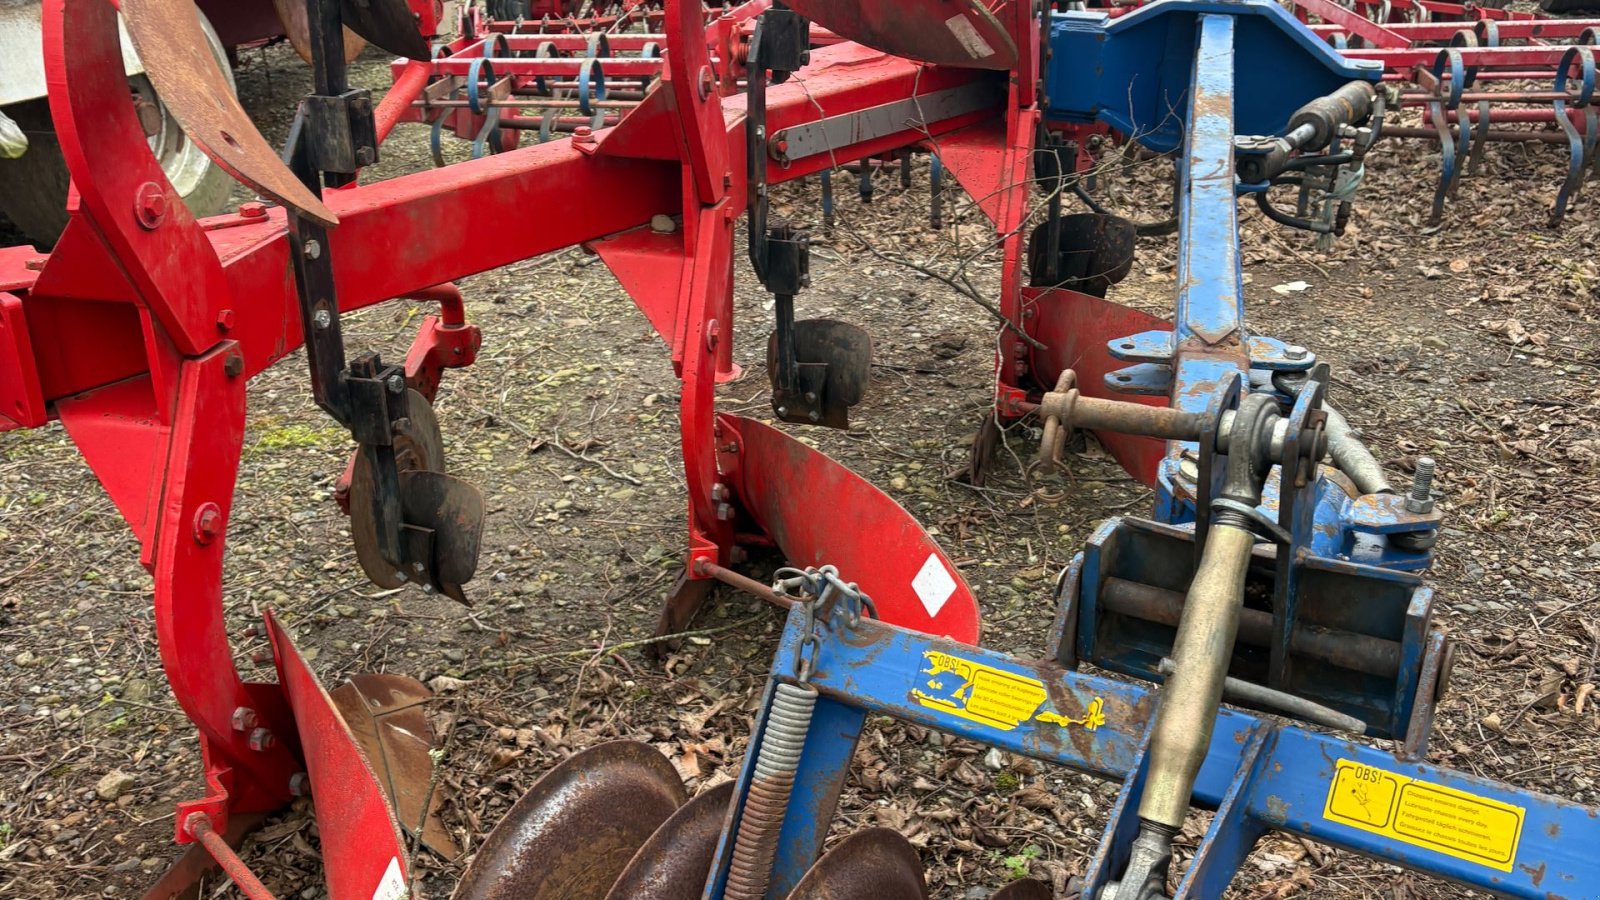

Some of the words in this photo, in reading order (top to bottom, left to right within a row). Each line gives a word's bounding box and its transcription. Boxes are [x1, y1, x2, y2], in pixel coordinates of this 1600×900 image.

[1355, 766, 1383, 785] OBS!
[1405, 801, 1433, 812] Lubricate
[1458, 816, 1475, 825] every
